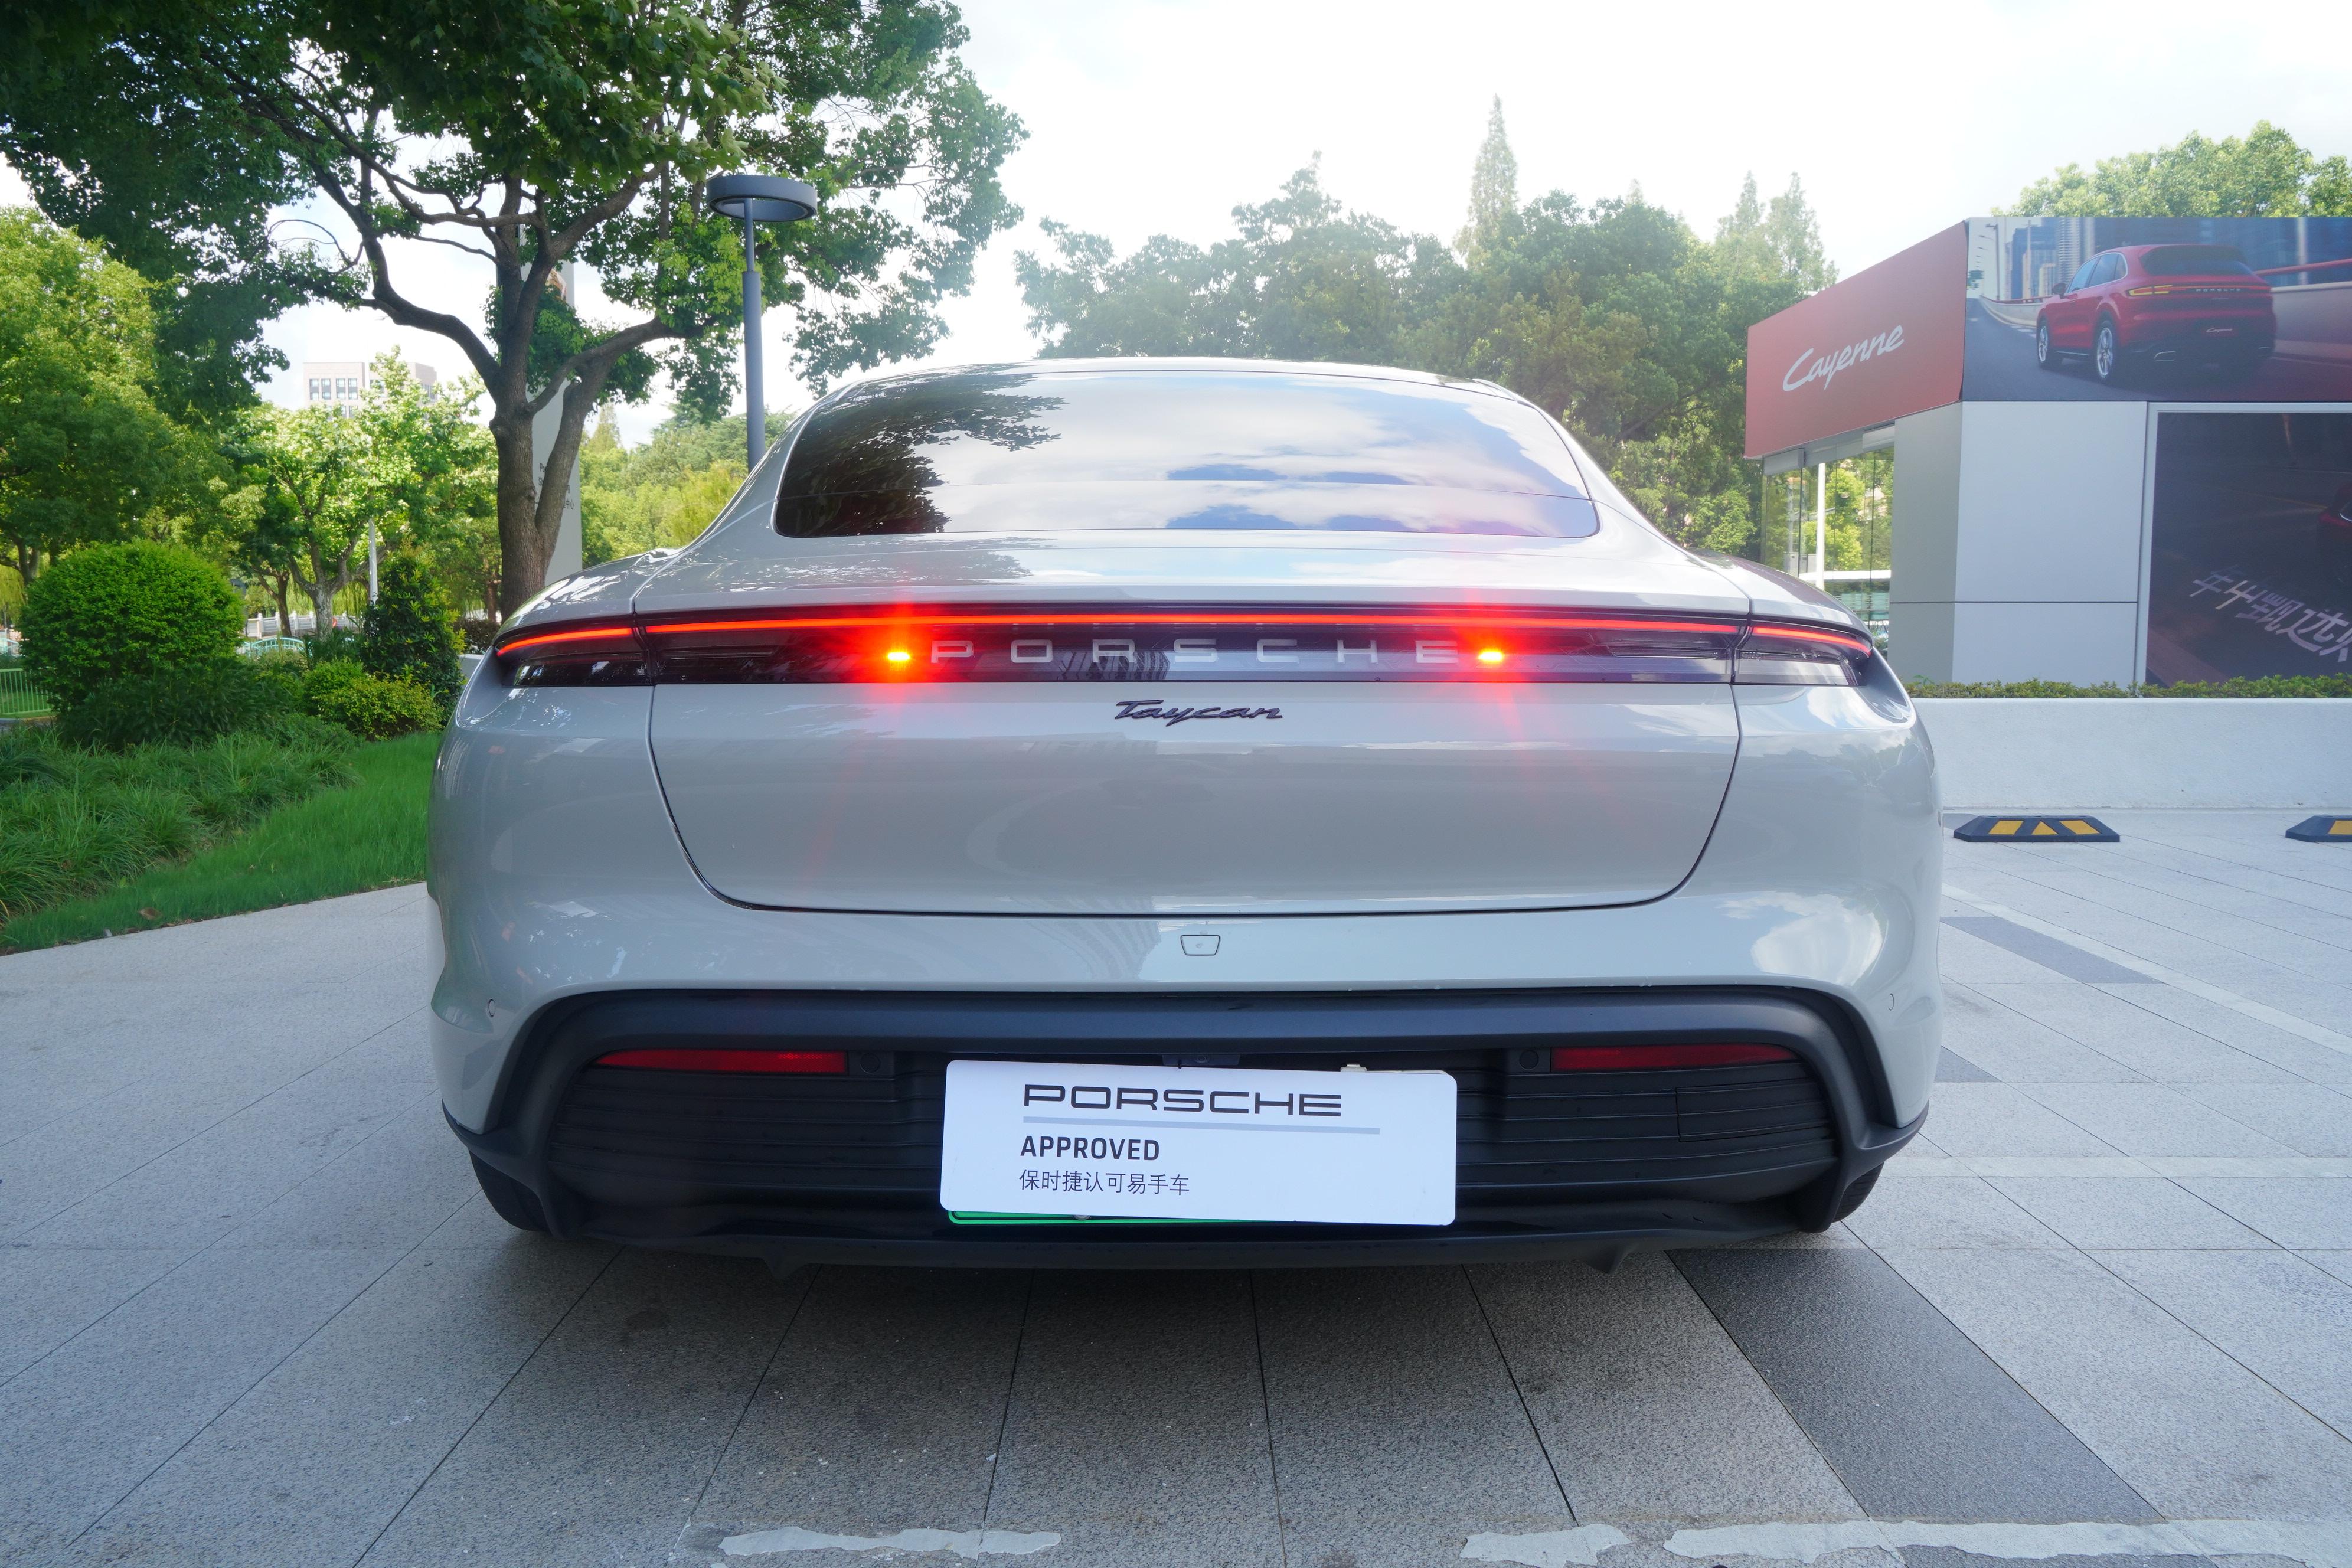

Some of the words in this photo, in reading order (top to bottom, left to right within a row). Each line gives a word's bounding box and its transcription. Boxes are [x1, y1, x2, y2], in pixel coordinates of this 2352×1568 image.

[1782, 325, 1905, 391] Cayenne
[931, 639, 1458, 664] PORSCHE
[1115, 700, 1283, 727] Taycan
[1024, 1084, 1342, 1117] PORSCHE
[1020, 1135, 1159, 1161] APPROVED
[1019, 1169, 1190, 1196] 保时捷认可易手车
